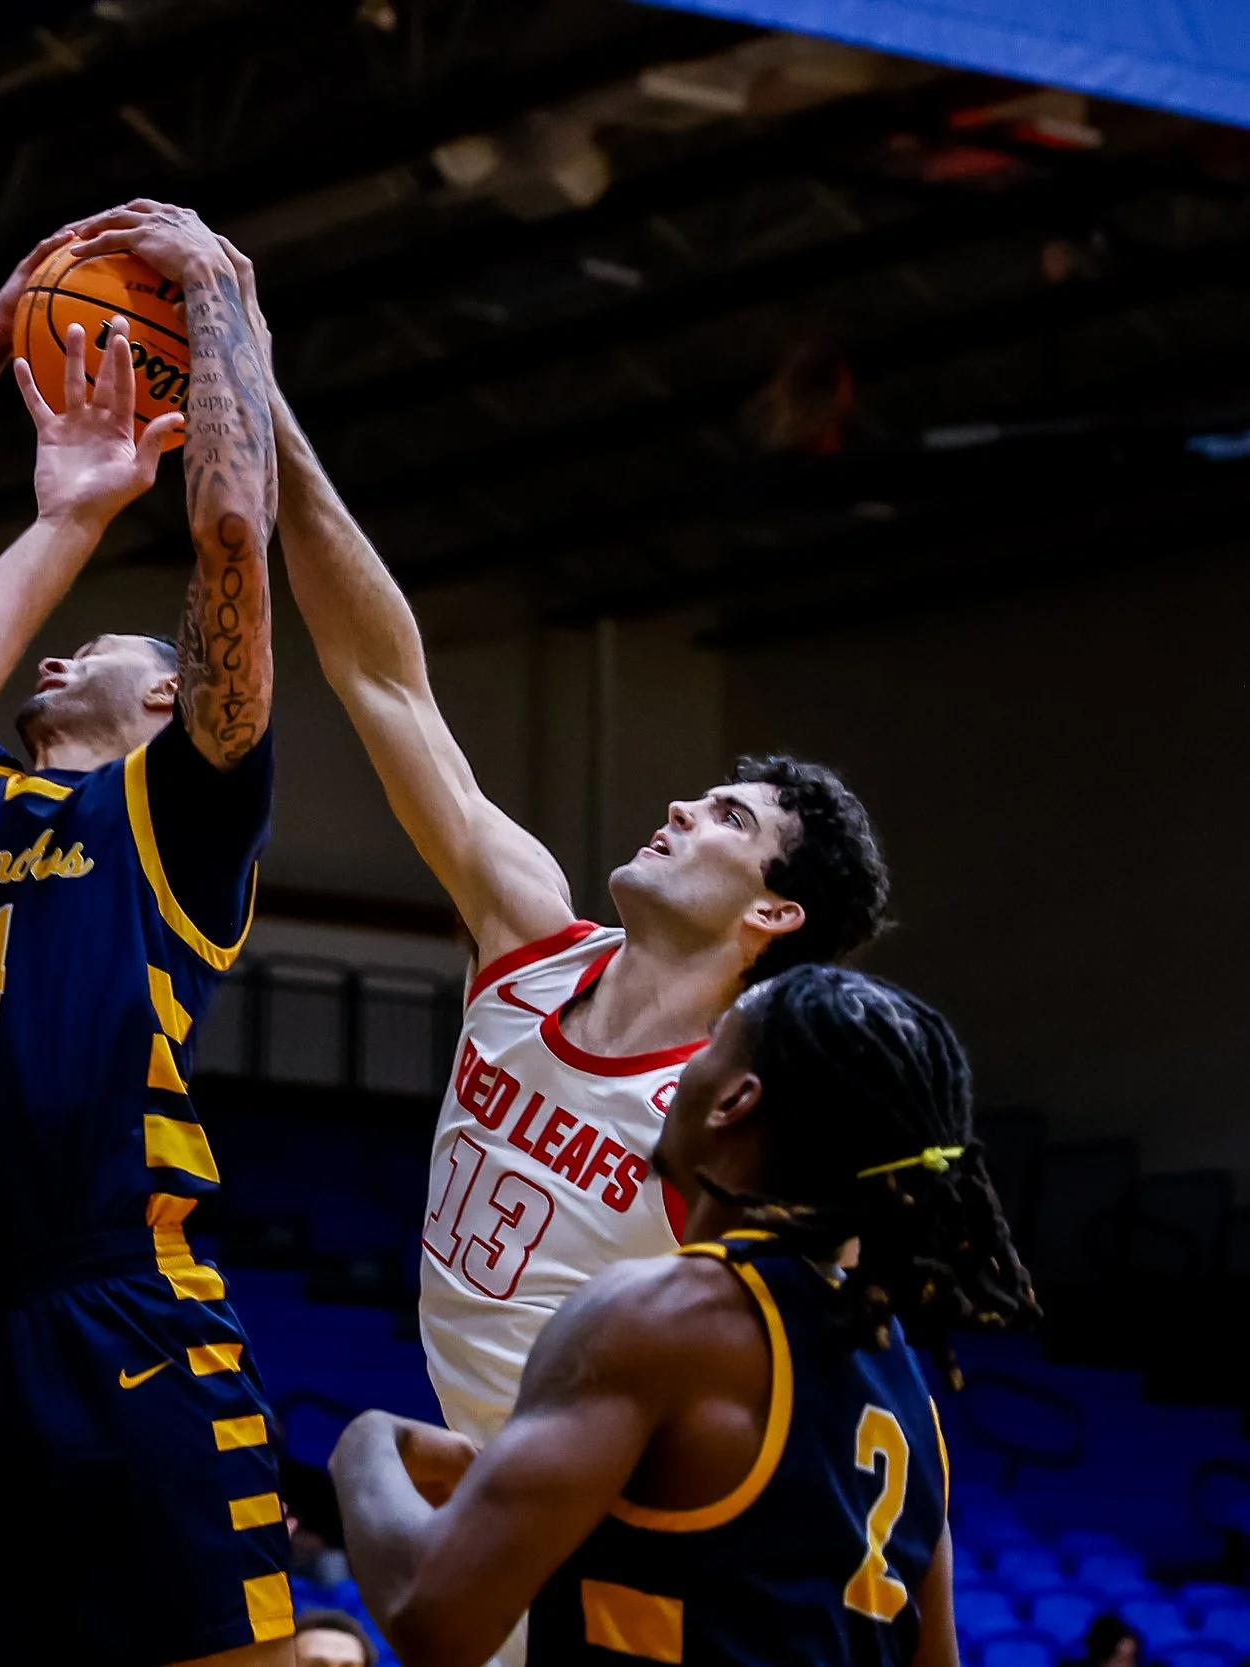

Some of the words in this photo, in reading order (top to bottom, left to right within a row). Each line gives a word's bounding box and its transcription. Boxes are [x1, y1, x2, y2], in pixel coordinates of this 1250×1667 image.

[196, 422, 230, 436] they
[454, 1036, 521, 1130] RED
[507, 1090, 649, 1214] LEAFS
[421, 1129, 556, 1301] 13
[842, 1402, 911, 1623] 2
